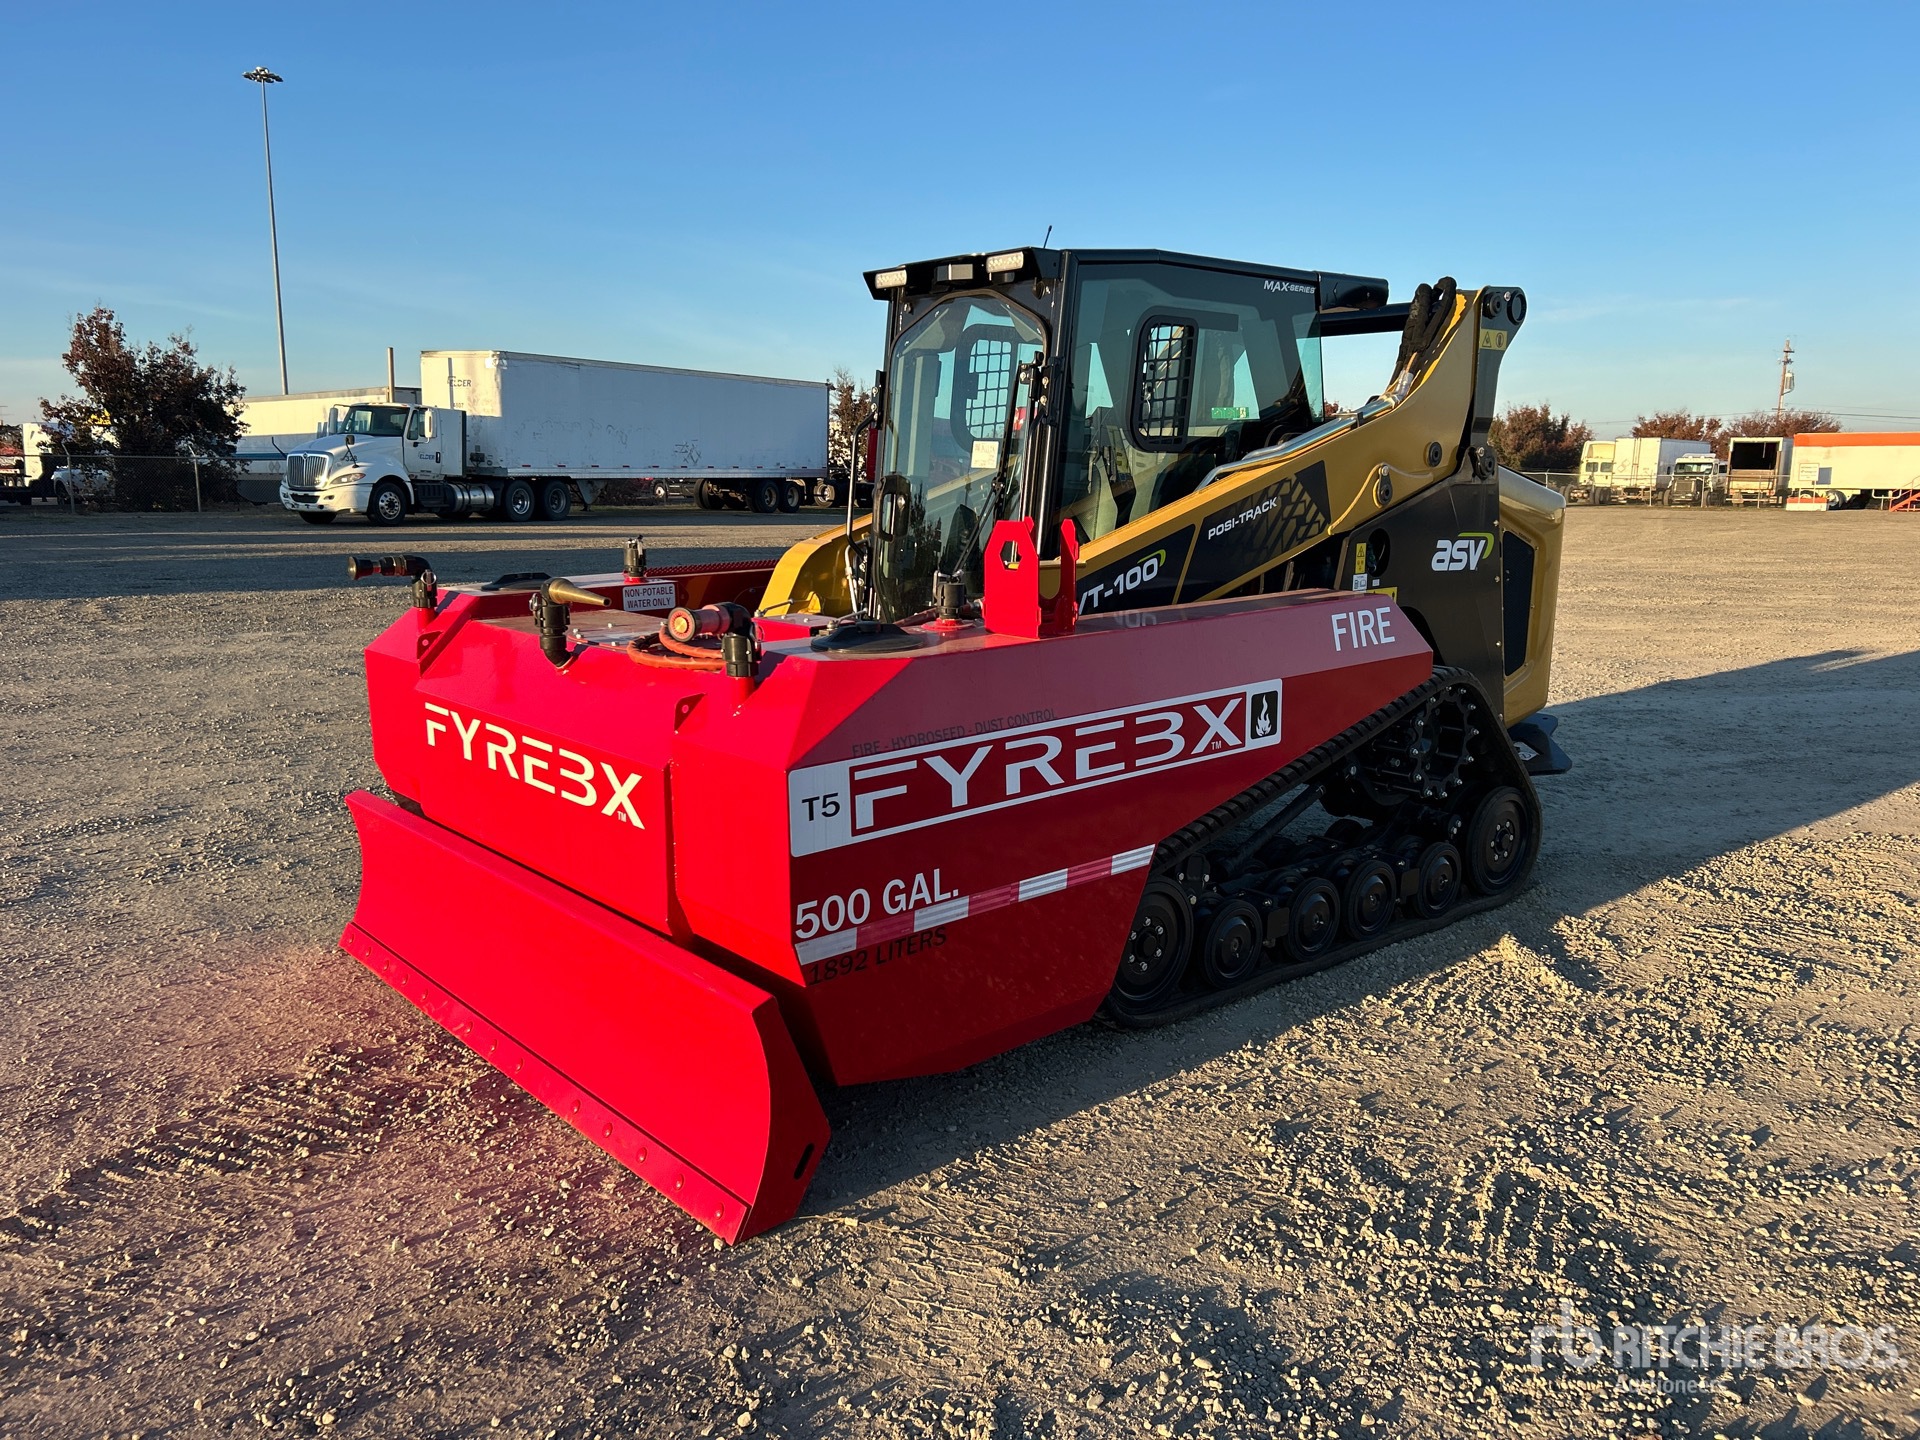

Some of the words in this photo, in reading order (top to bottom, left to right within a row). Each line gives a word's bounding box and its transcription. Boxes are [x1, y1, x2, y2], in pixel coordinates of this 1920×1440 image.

[1263, 280, 1316, 294] MAX-SERIES
[1208, 496, 1278, 540] POSI-TRACK
[624, 586, 674, 598] NON-POTABLE
[627, 598, 652, 609] WATER
[652, 597, 672, 607] ONLY
[1331, 606, 1396, 652] FIRE
[851, 740, 881, 757] FIRE
[974, 717, 1005, 735] DUST
[1007, 708, 1058, 728] CONTROL
[801, 792, 841, 822] T5
[795, 888, 871, 939] 500
[882, 868, 959, 915] GAL.
[808, 950, 869, 985] 1892
[876, 926, 948, 965] LITERS
